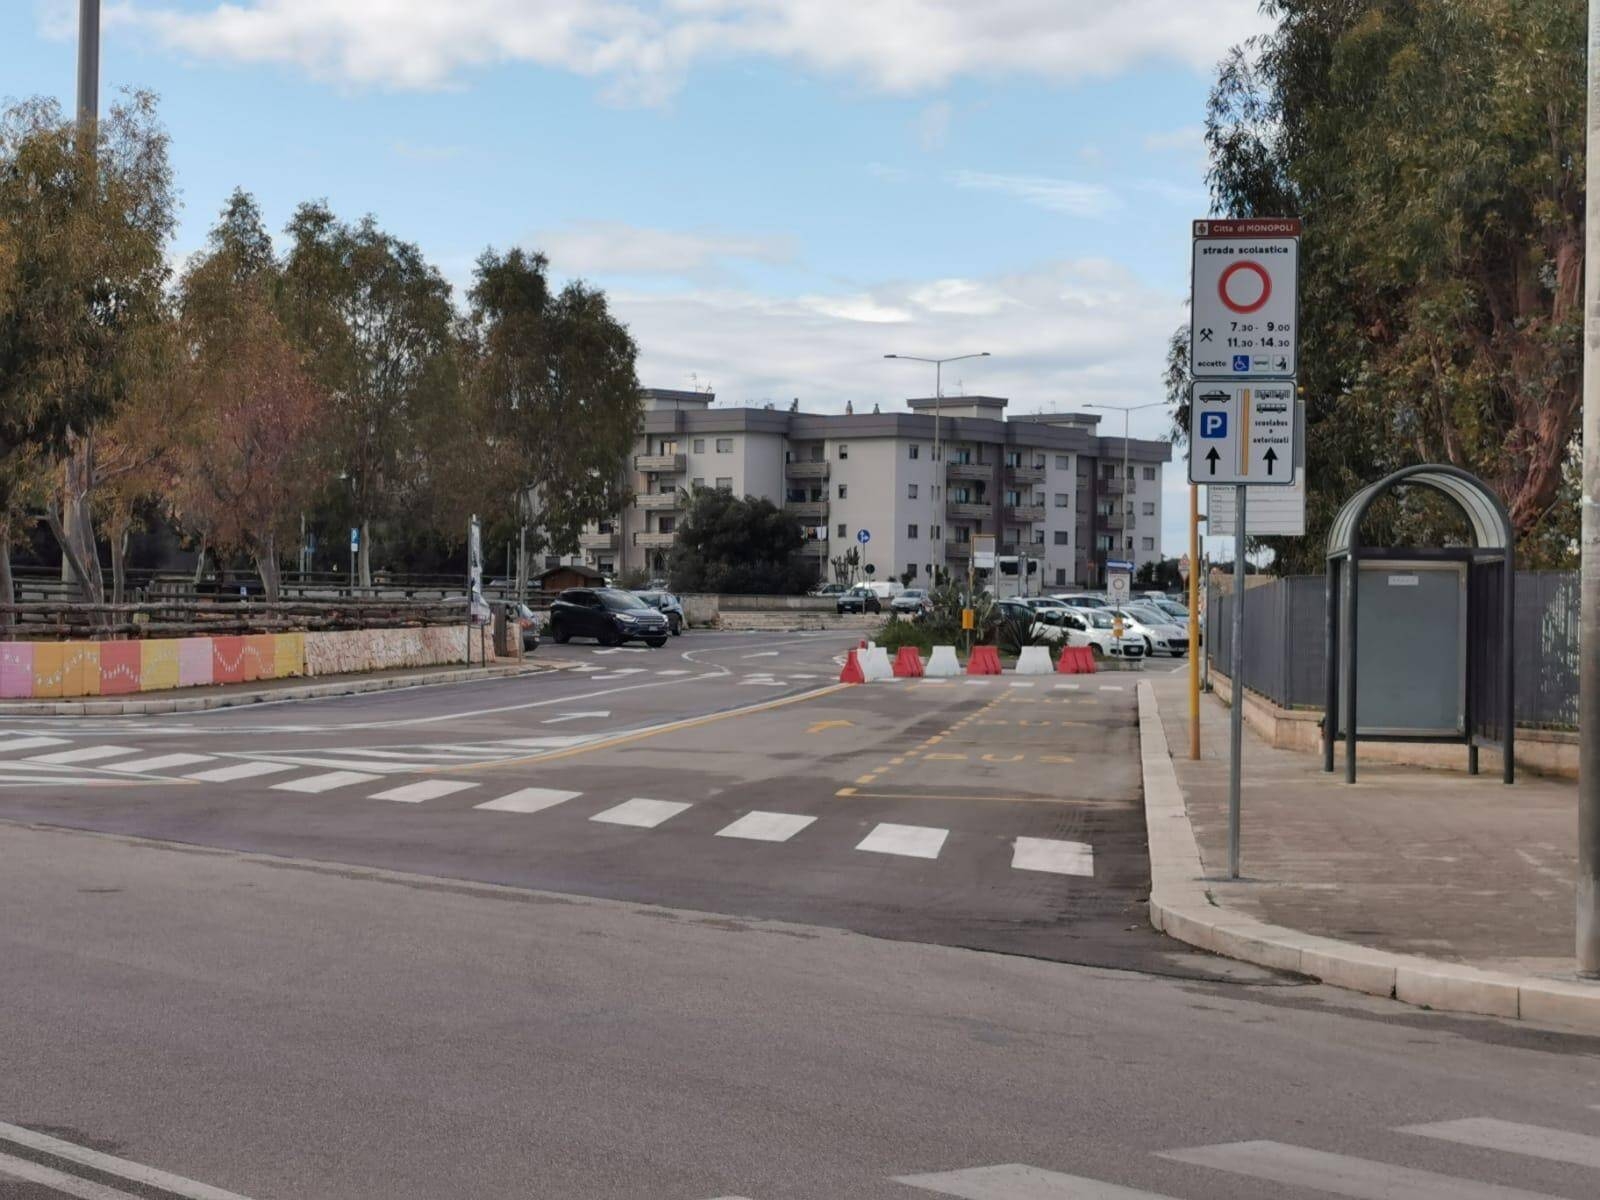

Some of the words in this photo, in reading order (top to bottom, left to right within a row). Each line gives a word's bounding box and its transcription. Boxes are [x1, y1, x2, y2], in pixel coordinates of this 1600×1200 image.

[1237, 224, 1245, 232] di
[1247, 224, 1294, 232] MONOPOLI
[1203, 246, 1234, 255] strada
[1238, 245, 1288, 254] scolastica
[1267, 321, 1290, 332] 9.00
[1227, 337, 1253, 348] 11.30
[1261, 337, 1290, 347] 14.30
[1206, 415, 1222, 435] P
[1253, 436, 1289, 444] autorizzati
